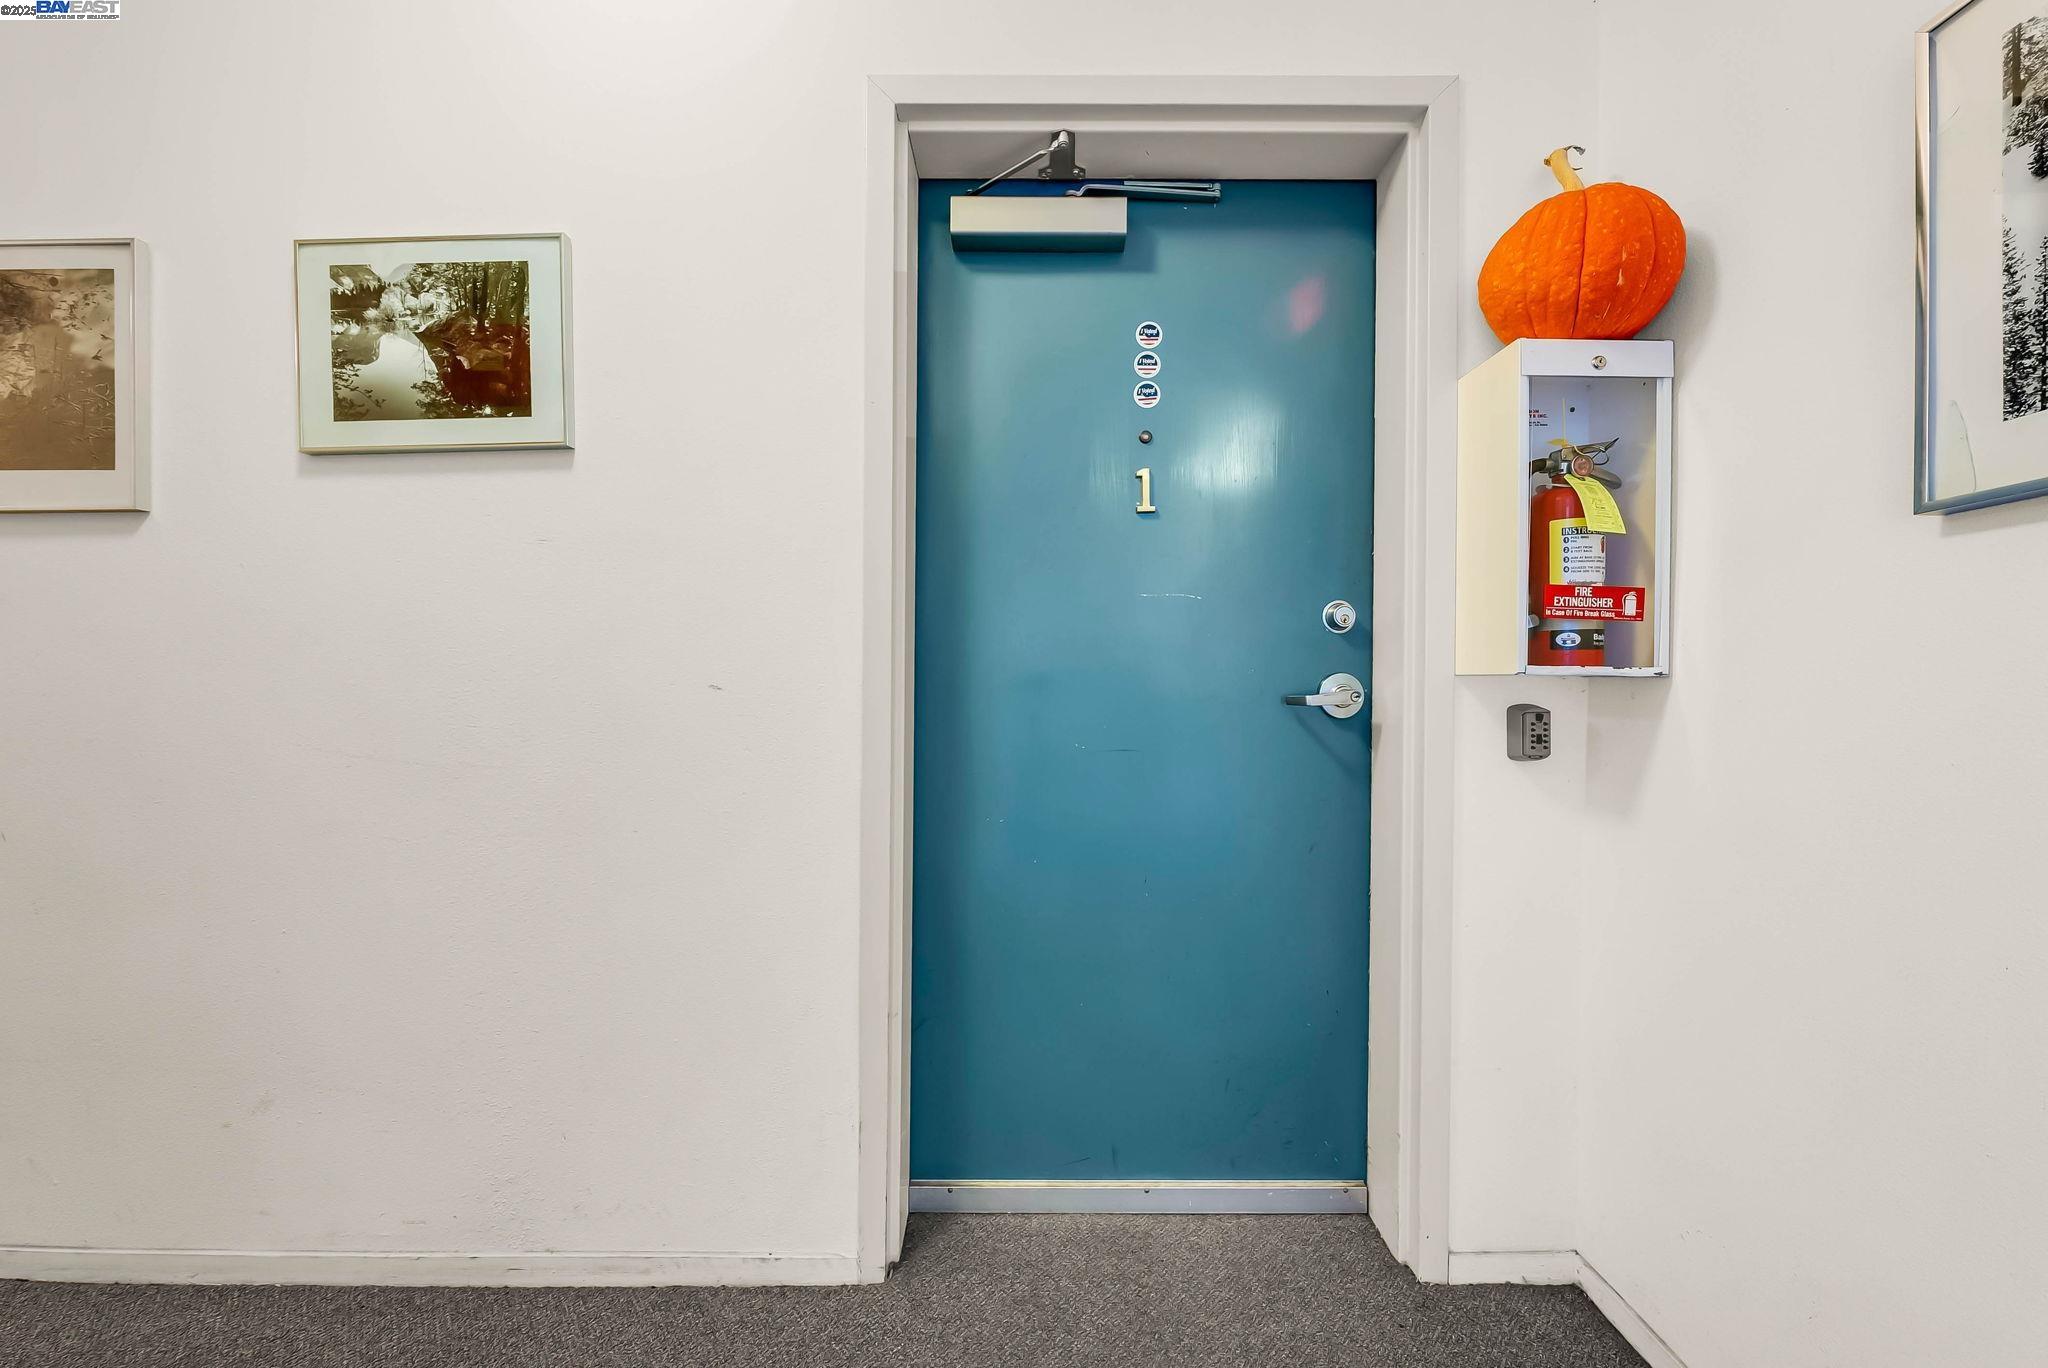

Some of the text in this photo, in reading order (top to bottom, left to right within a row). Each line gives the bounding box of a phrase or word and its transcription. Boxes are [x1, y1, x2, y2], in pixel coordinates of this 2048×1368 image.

[1135, 467, 1156, 514] 1
[1575, 587, 1593, 597] FIRE
[1554, 596, 1614, 608] EXTINGUISHER
